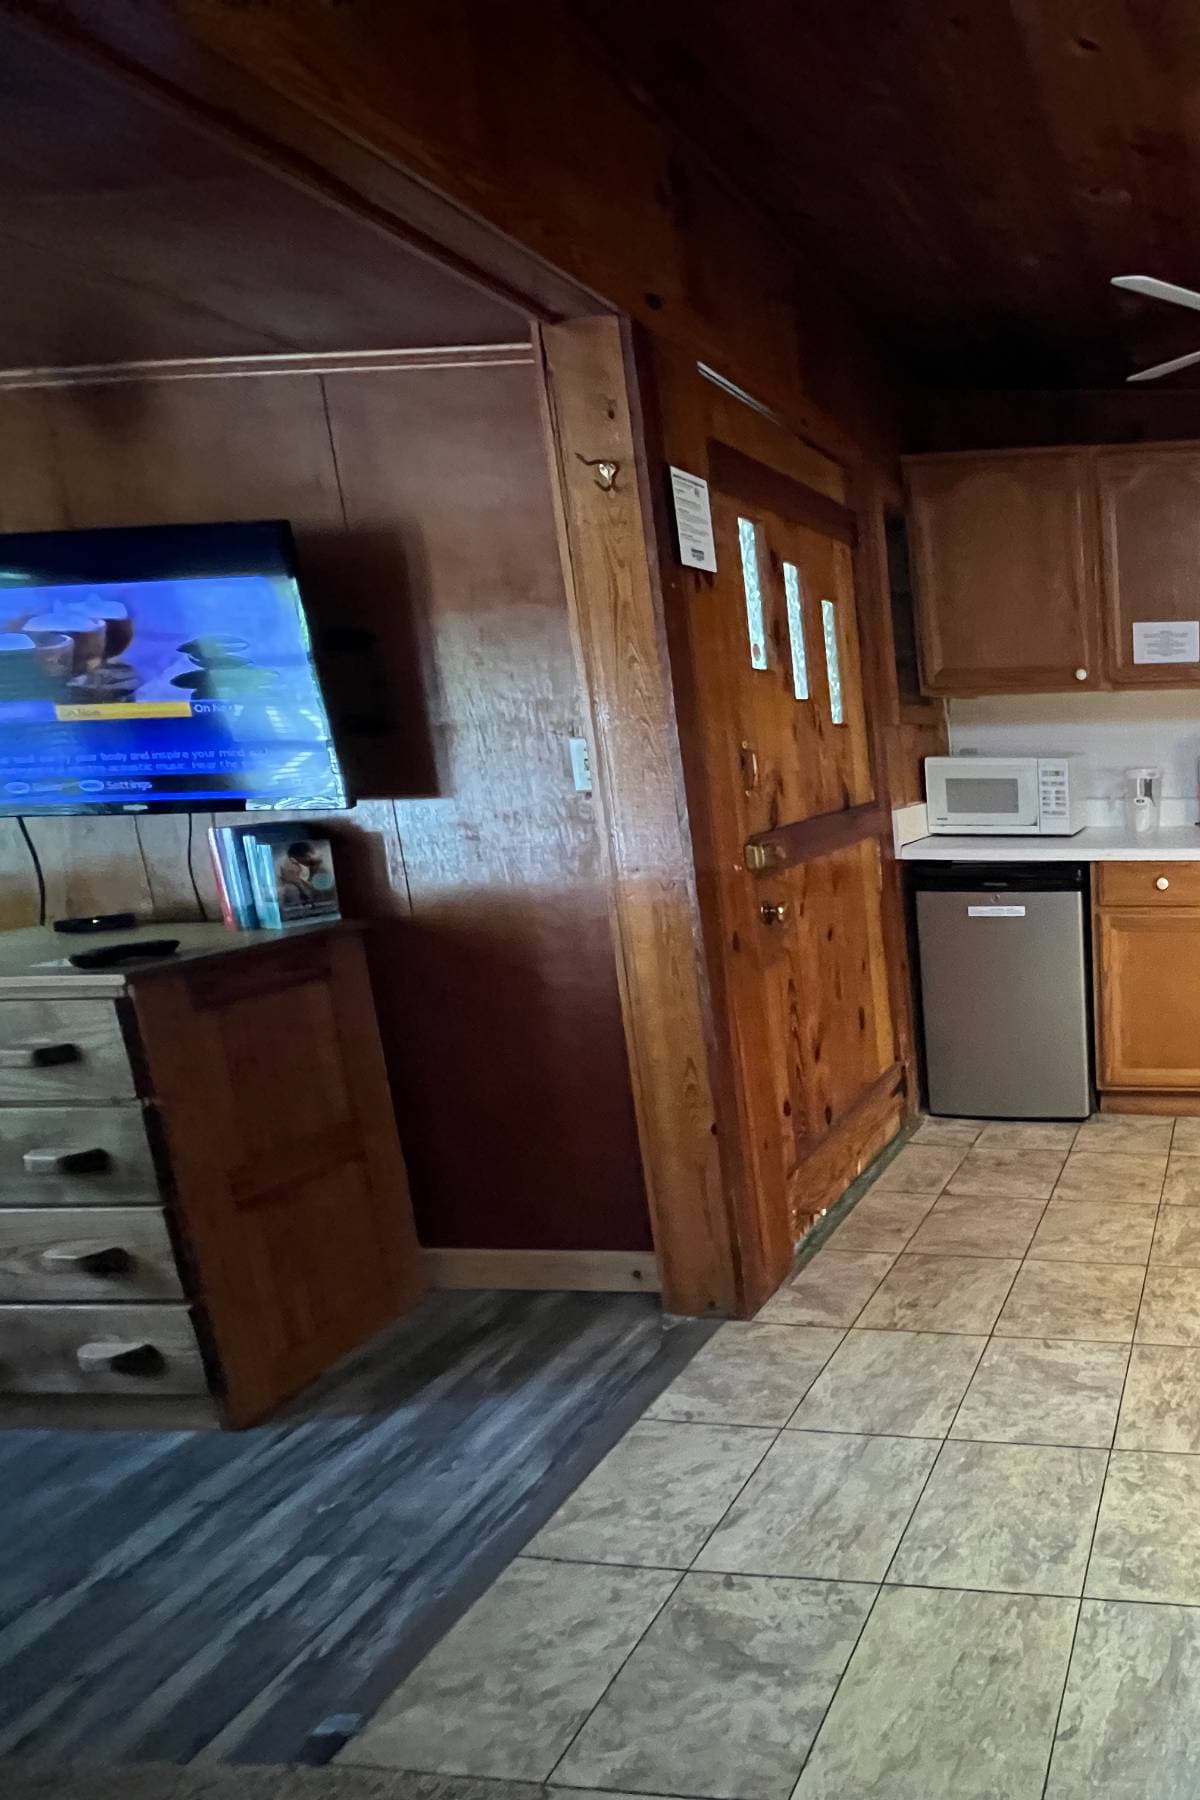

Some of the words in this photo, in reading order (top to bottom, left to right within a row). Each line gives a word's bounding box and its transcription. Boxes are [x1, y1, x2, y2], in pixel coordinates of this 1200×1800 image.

[194, 703, 211, 713] On
[191, 750, 215, 760] your
[105, 780, 152, 791] Settings
